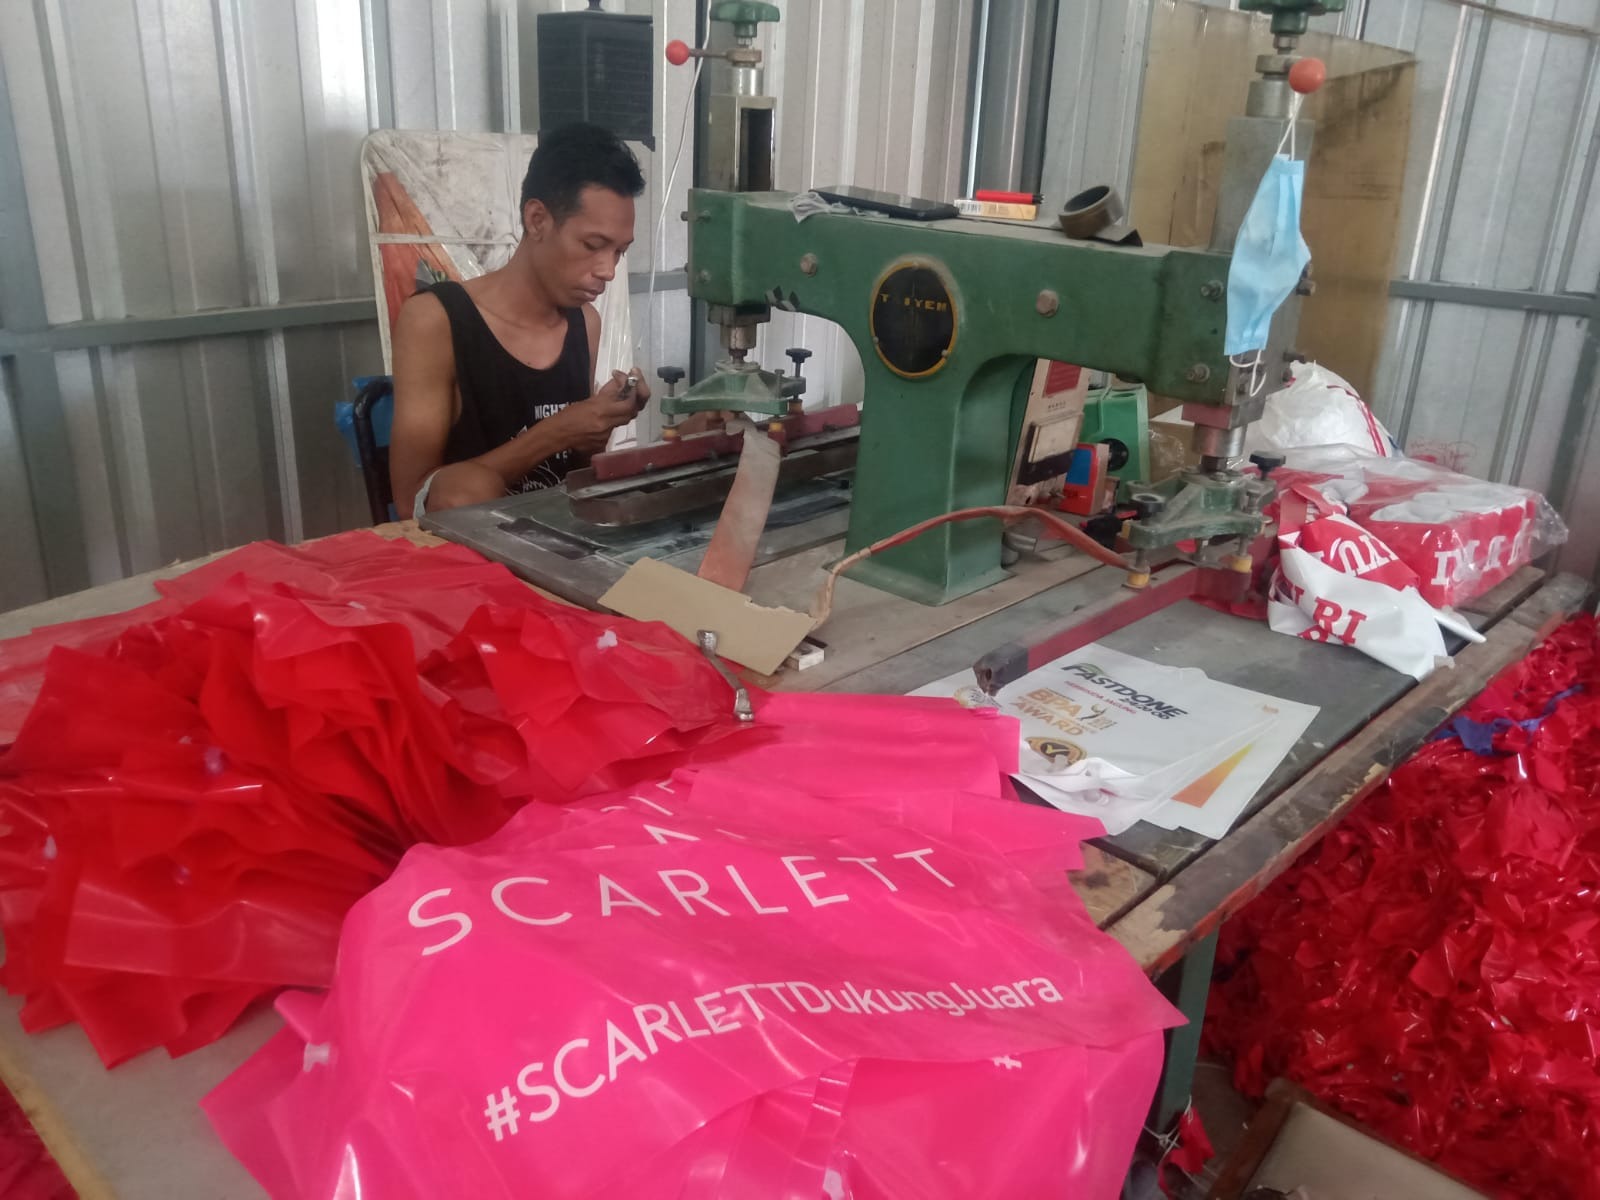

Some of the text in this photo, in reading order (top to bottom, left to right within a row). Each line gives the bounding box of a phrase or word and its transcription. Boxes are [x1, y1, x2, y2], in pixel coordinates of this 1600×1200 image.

[1009, 700, 1084, 736] AWARD
[1061, 664, 1188, 718] FASTDONE
[407, 847, 956, 957] SCARLETT
[483, 977, 1064, 1143] #SCARLETTDukungJuara
